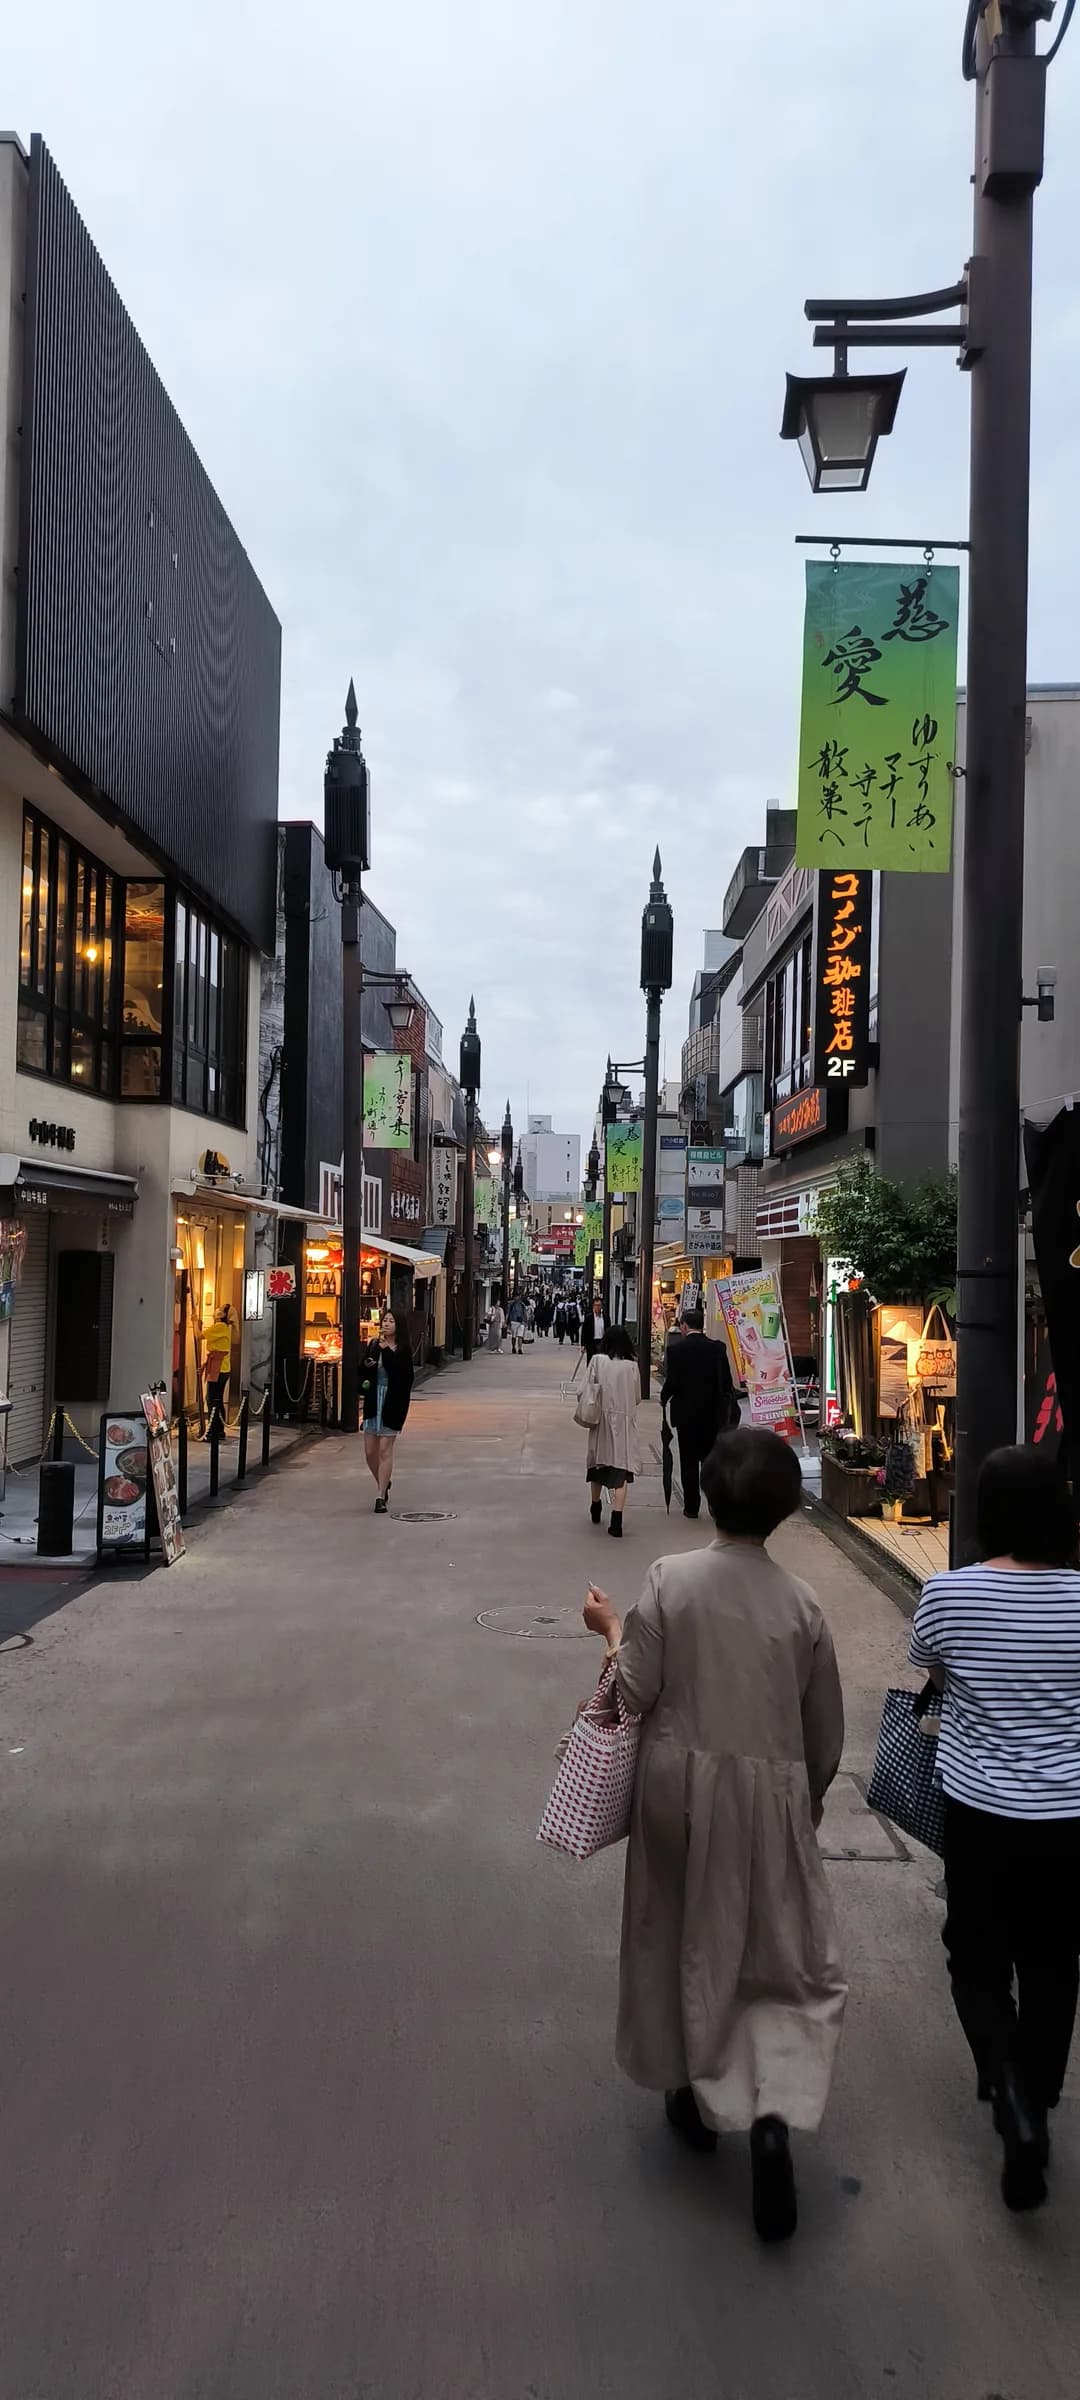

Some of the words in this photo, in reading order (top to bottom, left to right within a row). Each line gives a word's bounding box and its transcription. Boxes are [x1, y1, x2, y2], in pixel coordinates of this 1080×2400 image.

[881, 578, 949, 642] 慈
[821, 625, 890, 706] 愛
[808, 739, 849, 847] 散策へ
[850, 762, 877, 847] 守って
[880, 752, 903, 829] マナー
[906, 713, 940, 852] ゆずりあい
[823, 873, 862, 1053] コメダ珈琲店
[827, 1057, 856, 1077] 2F
[270, 1270, 292, 1294] 氷
[754, 1394, 788, 1407] Smoothie
